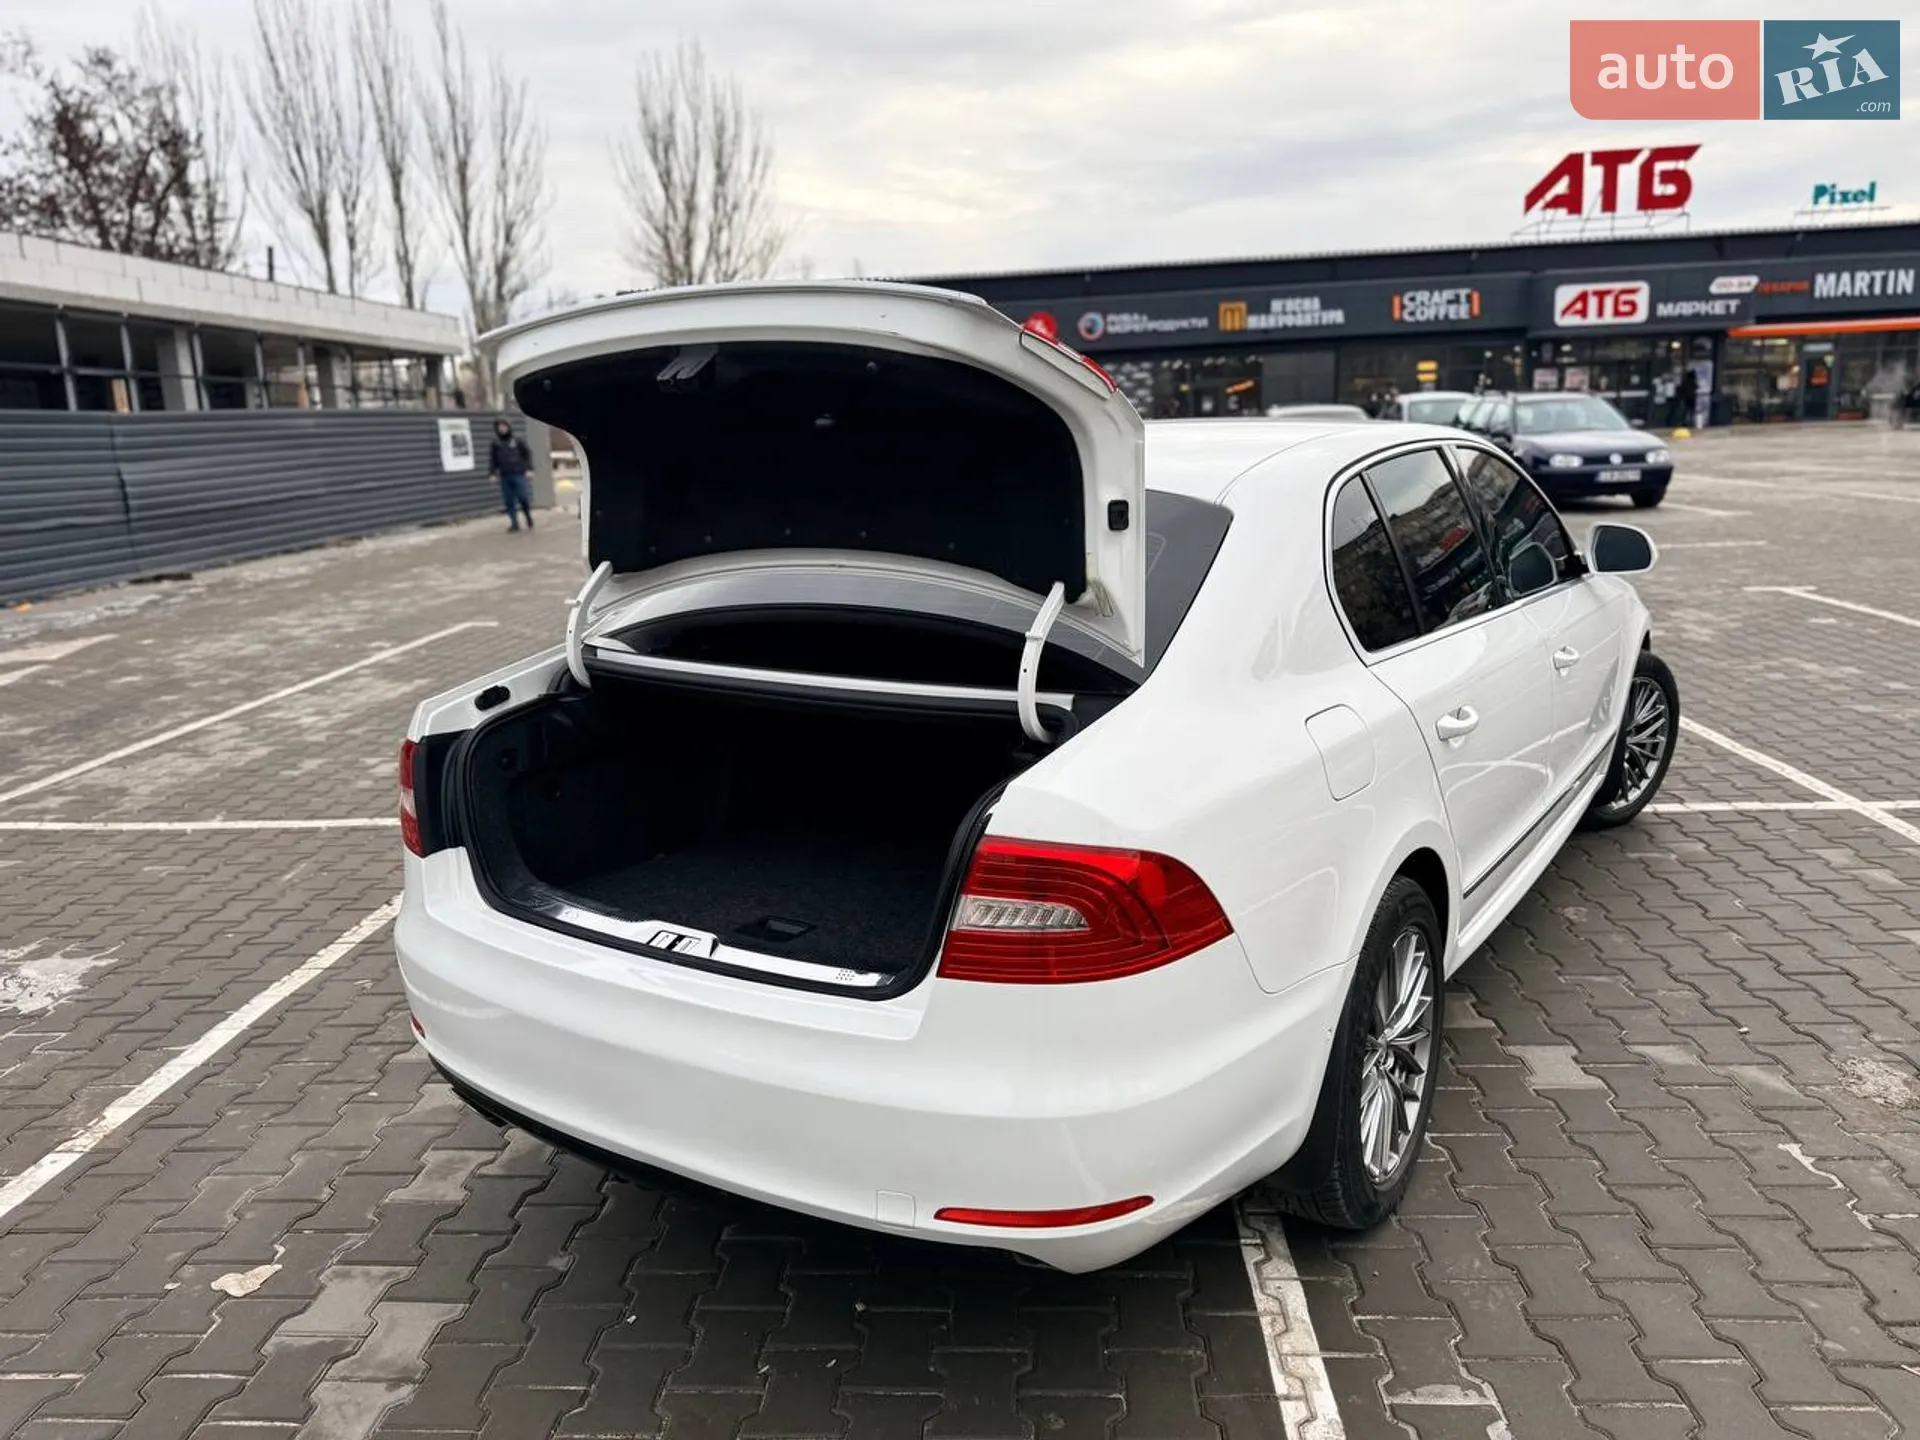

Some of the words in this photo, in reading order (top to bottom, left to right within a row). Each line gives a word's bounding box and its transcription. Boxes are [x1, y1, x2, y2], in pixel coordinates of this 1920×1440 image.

[1524, 143, 1703, 216] АТБ
[1812, 181, 1877, 206] Pixel
[1813, 268, 1916, 299] MARTIN
[1402, 287, 1472, 306] CRAFT
[1560, 286, 1643, 321] АТБ
[1656, 298, 1741, 319] МАРКЕТ
[1402, 302, 1471, 322] COFFEE
